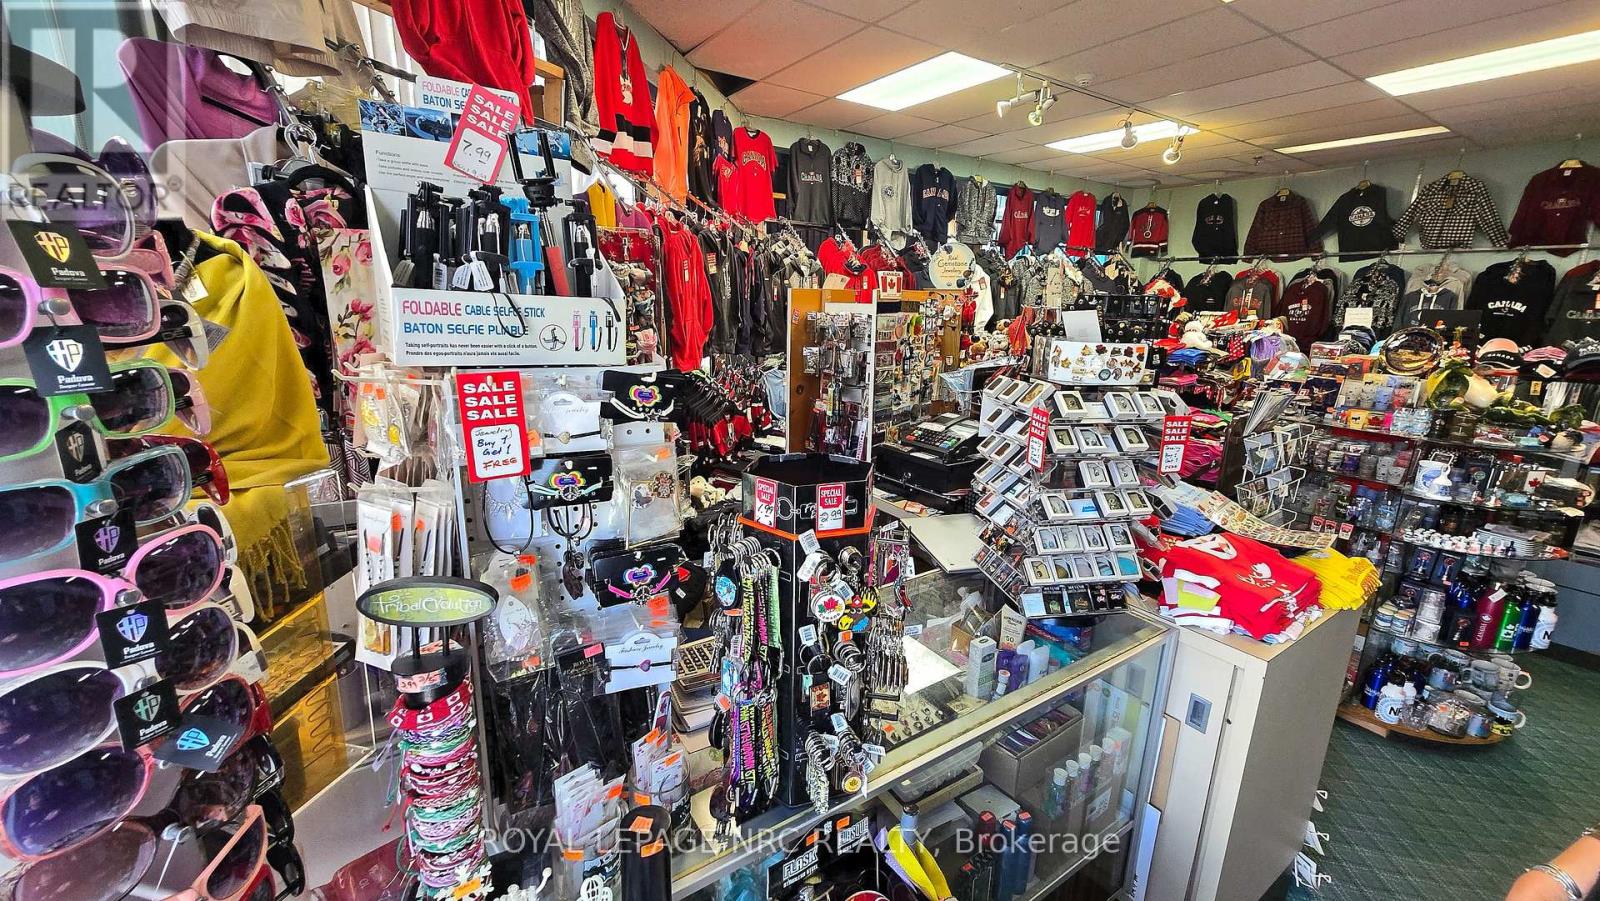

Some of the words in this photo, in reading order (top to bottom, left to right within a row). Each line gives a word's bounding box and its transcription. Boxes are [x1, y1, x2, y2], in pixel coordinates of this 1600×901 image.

[422, 81, 460, 96] FOLDABLE
[423, 94, 452, 108] BATON
[473, 94, 515, 121] SALE
[469, 104, 512, 132] SALE
[466, 114, 507, 141] SALE
[50, 267, 86, 277] Padova
[402, 300, 462, 316] FOLDABLE
[464, 304, 491, 316] CABLE
[524, 307, 546, 318] STICK
[403, 322, 443, 334] BATON
[447, 323, 484, 334] SELFIE
[488, 325, 529, 336] PLIABLE
[57, 374, 94, 384] Padova
[463, 381, 515, 394] SALE
[464, 396, 517, 407] SALE
[466, 407, 519, 421] SALE
[1033, 412, 1047, 421] SALE
[1032, 419, 1046, 429] SALE
[1031, 426, 1045, 436] SALE
[477, 439, 496, 448] Buy
[483, 447, 502, 456] Get
[758, 483, 774, 495] SPECIAL
[820, 488, 842, 498] SPECIAL
[761, 493, 771, 502] SALE
[820, 509, 842, 522] 2.99
[98, 552, 125, 567] Padova
[123, 640, 155, 655] Padova
[139, 720, 168, 737] Padova
[205, 734, 228, 757] Padova
[783, 845, 819, 879] FLASK
